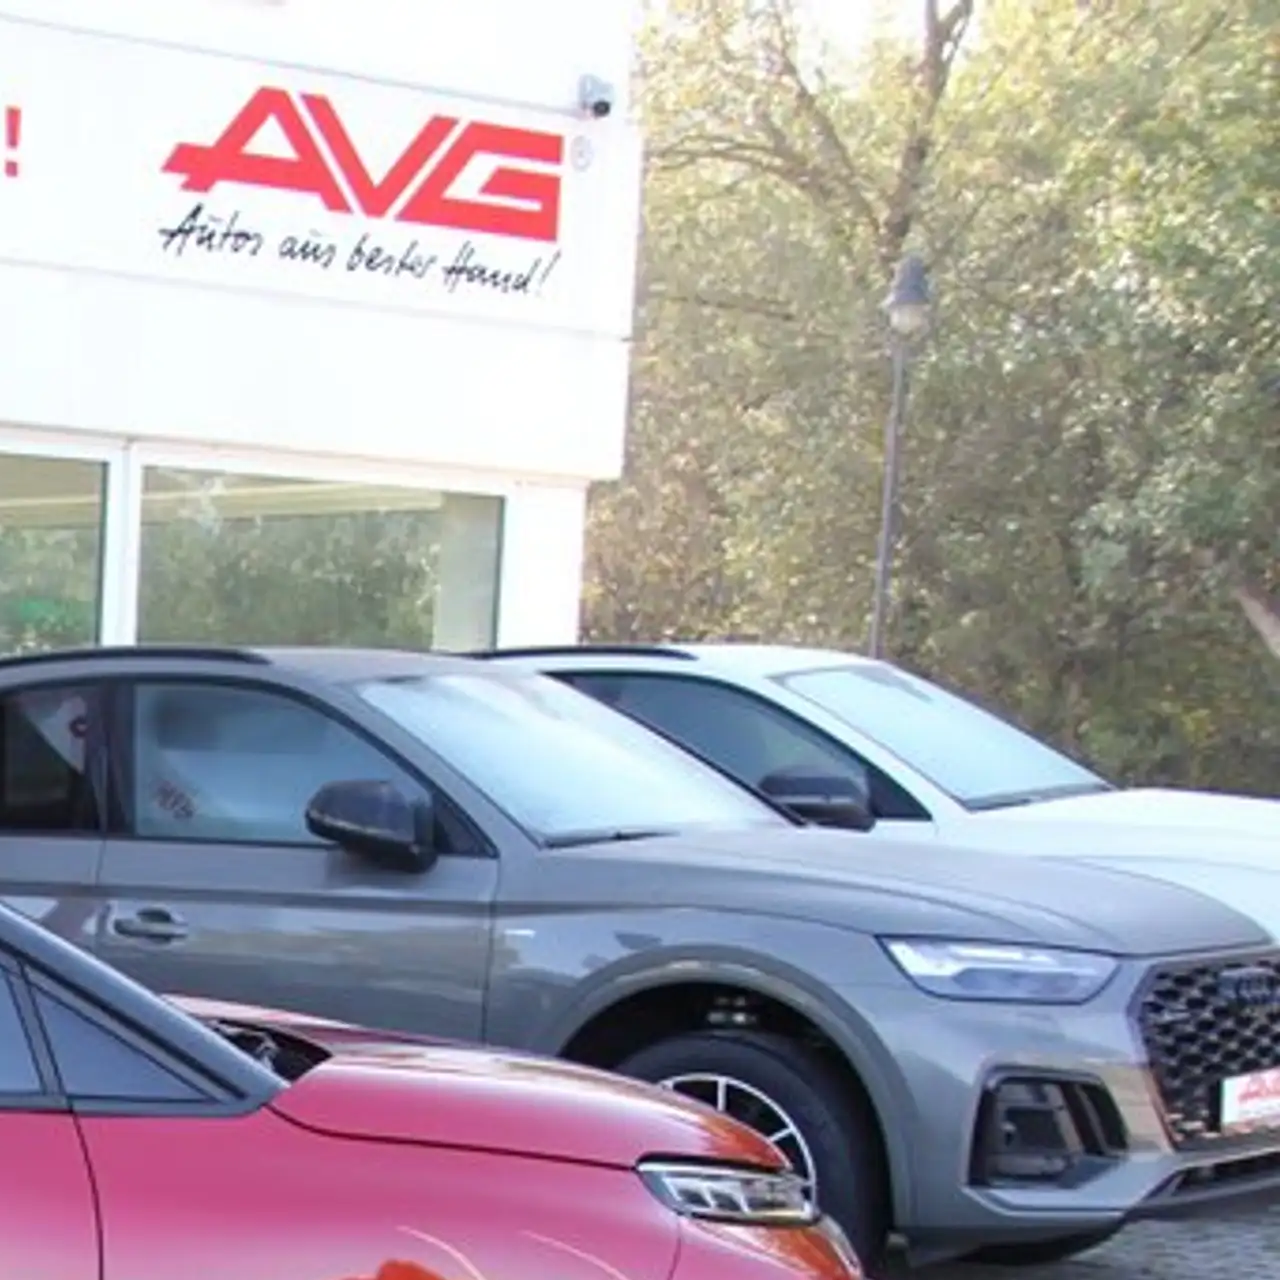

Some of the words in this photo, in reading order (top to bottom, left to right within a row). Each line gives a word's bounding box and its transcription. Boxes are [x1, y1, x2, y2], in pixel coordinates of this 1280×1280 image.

[160, 86, 563, 243] AVG
[158, 202, 264, 256] Autos
[278, 230, 338, 269] aus
